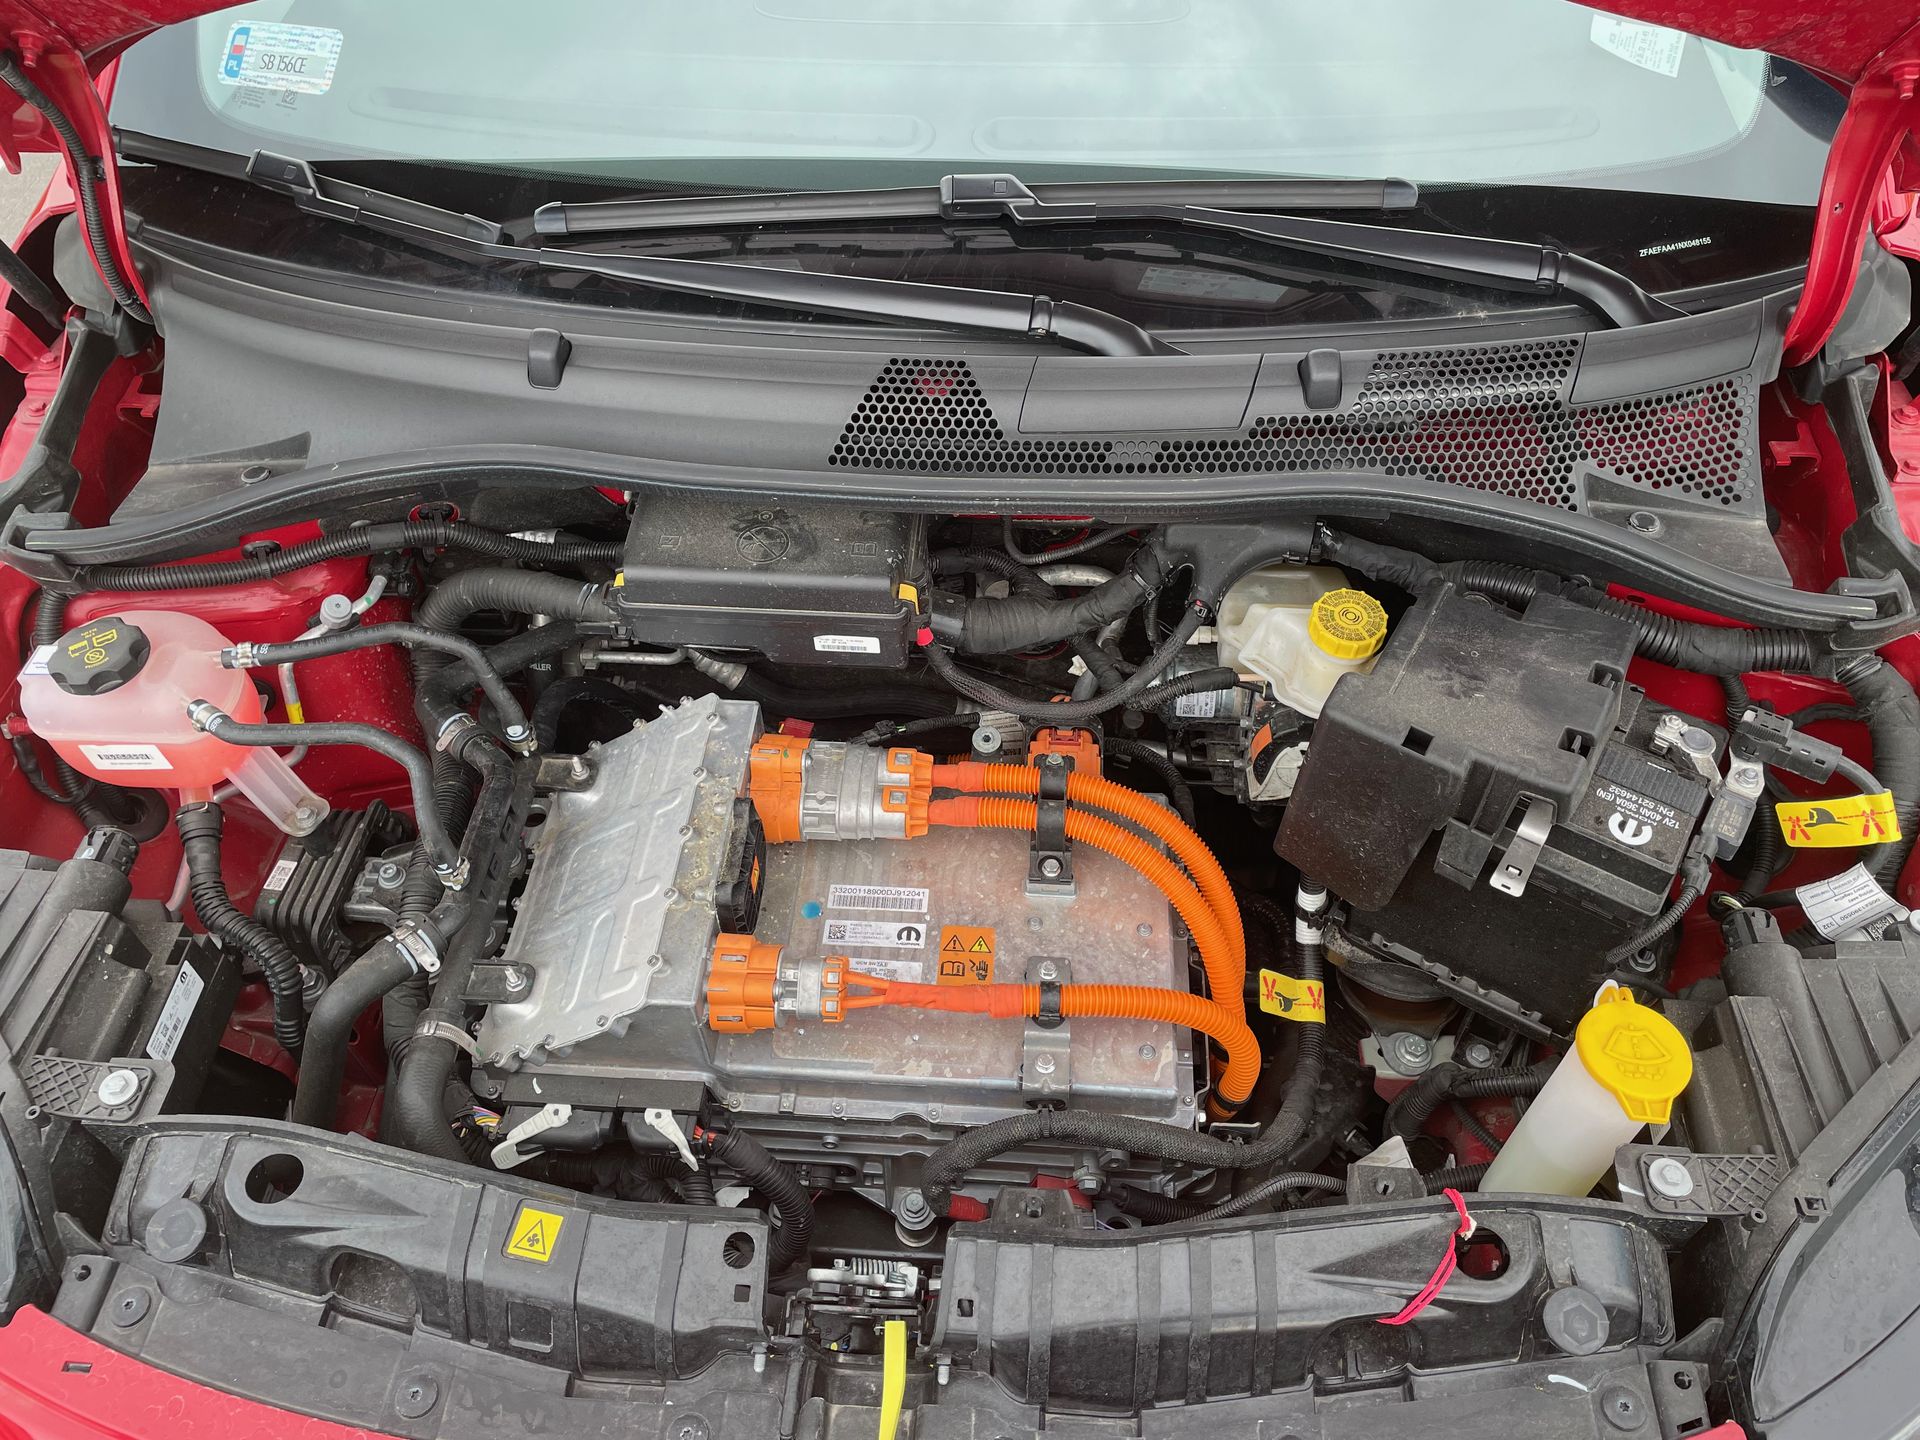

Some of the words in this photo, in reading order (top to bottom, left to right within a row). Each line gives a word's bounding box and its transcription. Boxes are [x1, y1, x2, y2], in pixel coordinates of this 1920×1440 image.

[227, 60, 239, 71] PL
[260, 53, 276, 70] SB
[276, 55, 308, 74] 156CE
[1596, 788, 1615, 801] (EN)
[1609, 785, 1656, 809] 52144632
[1616, 797, 1639, 811] 360A
[1640, 807, 1662, 821] 40Ah
[1657, 805, 1675, 817] PN:
[1662, 817, 1680, 829] 12V
[833, 886, 926, 897] 33200118900DJ912041
[1823, 922, 1836, 930] 332
